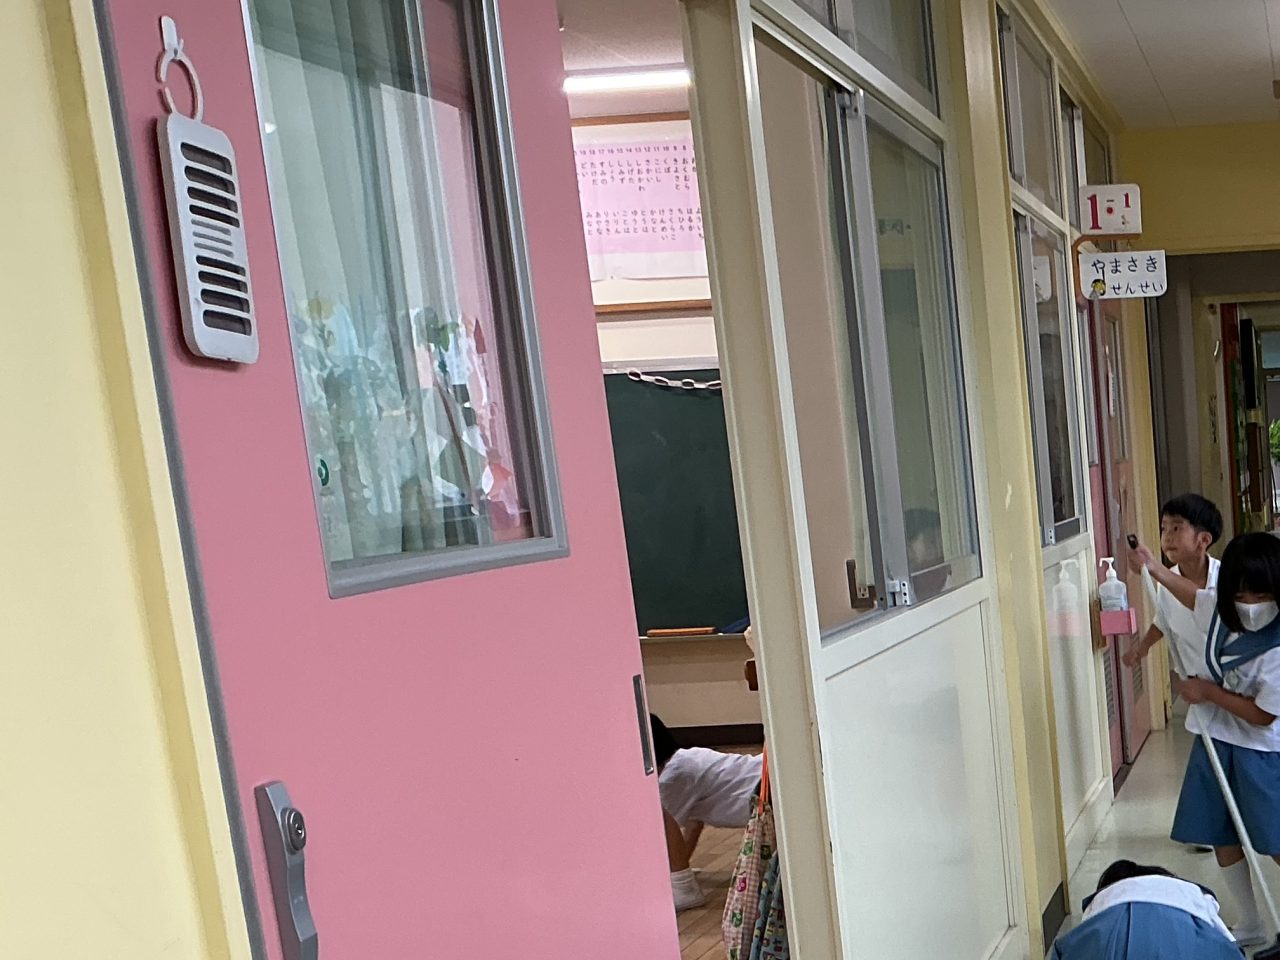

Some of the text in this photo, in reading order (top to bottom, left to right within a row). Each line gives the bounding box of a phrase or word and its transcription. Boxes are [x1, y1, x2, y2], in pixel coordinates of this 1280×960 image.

[1091, 255, 1158, 275] やまさき
[1111, 281, 1164, 295] せんせい
